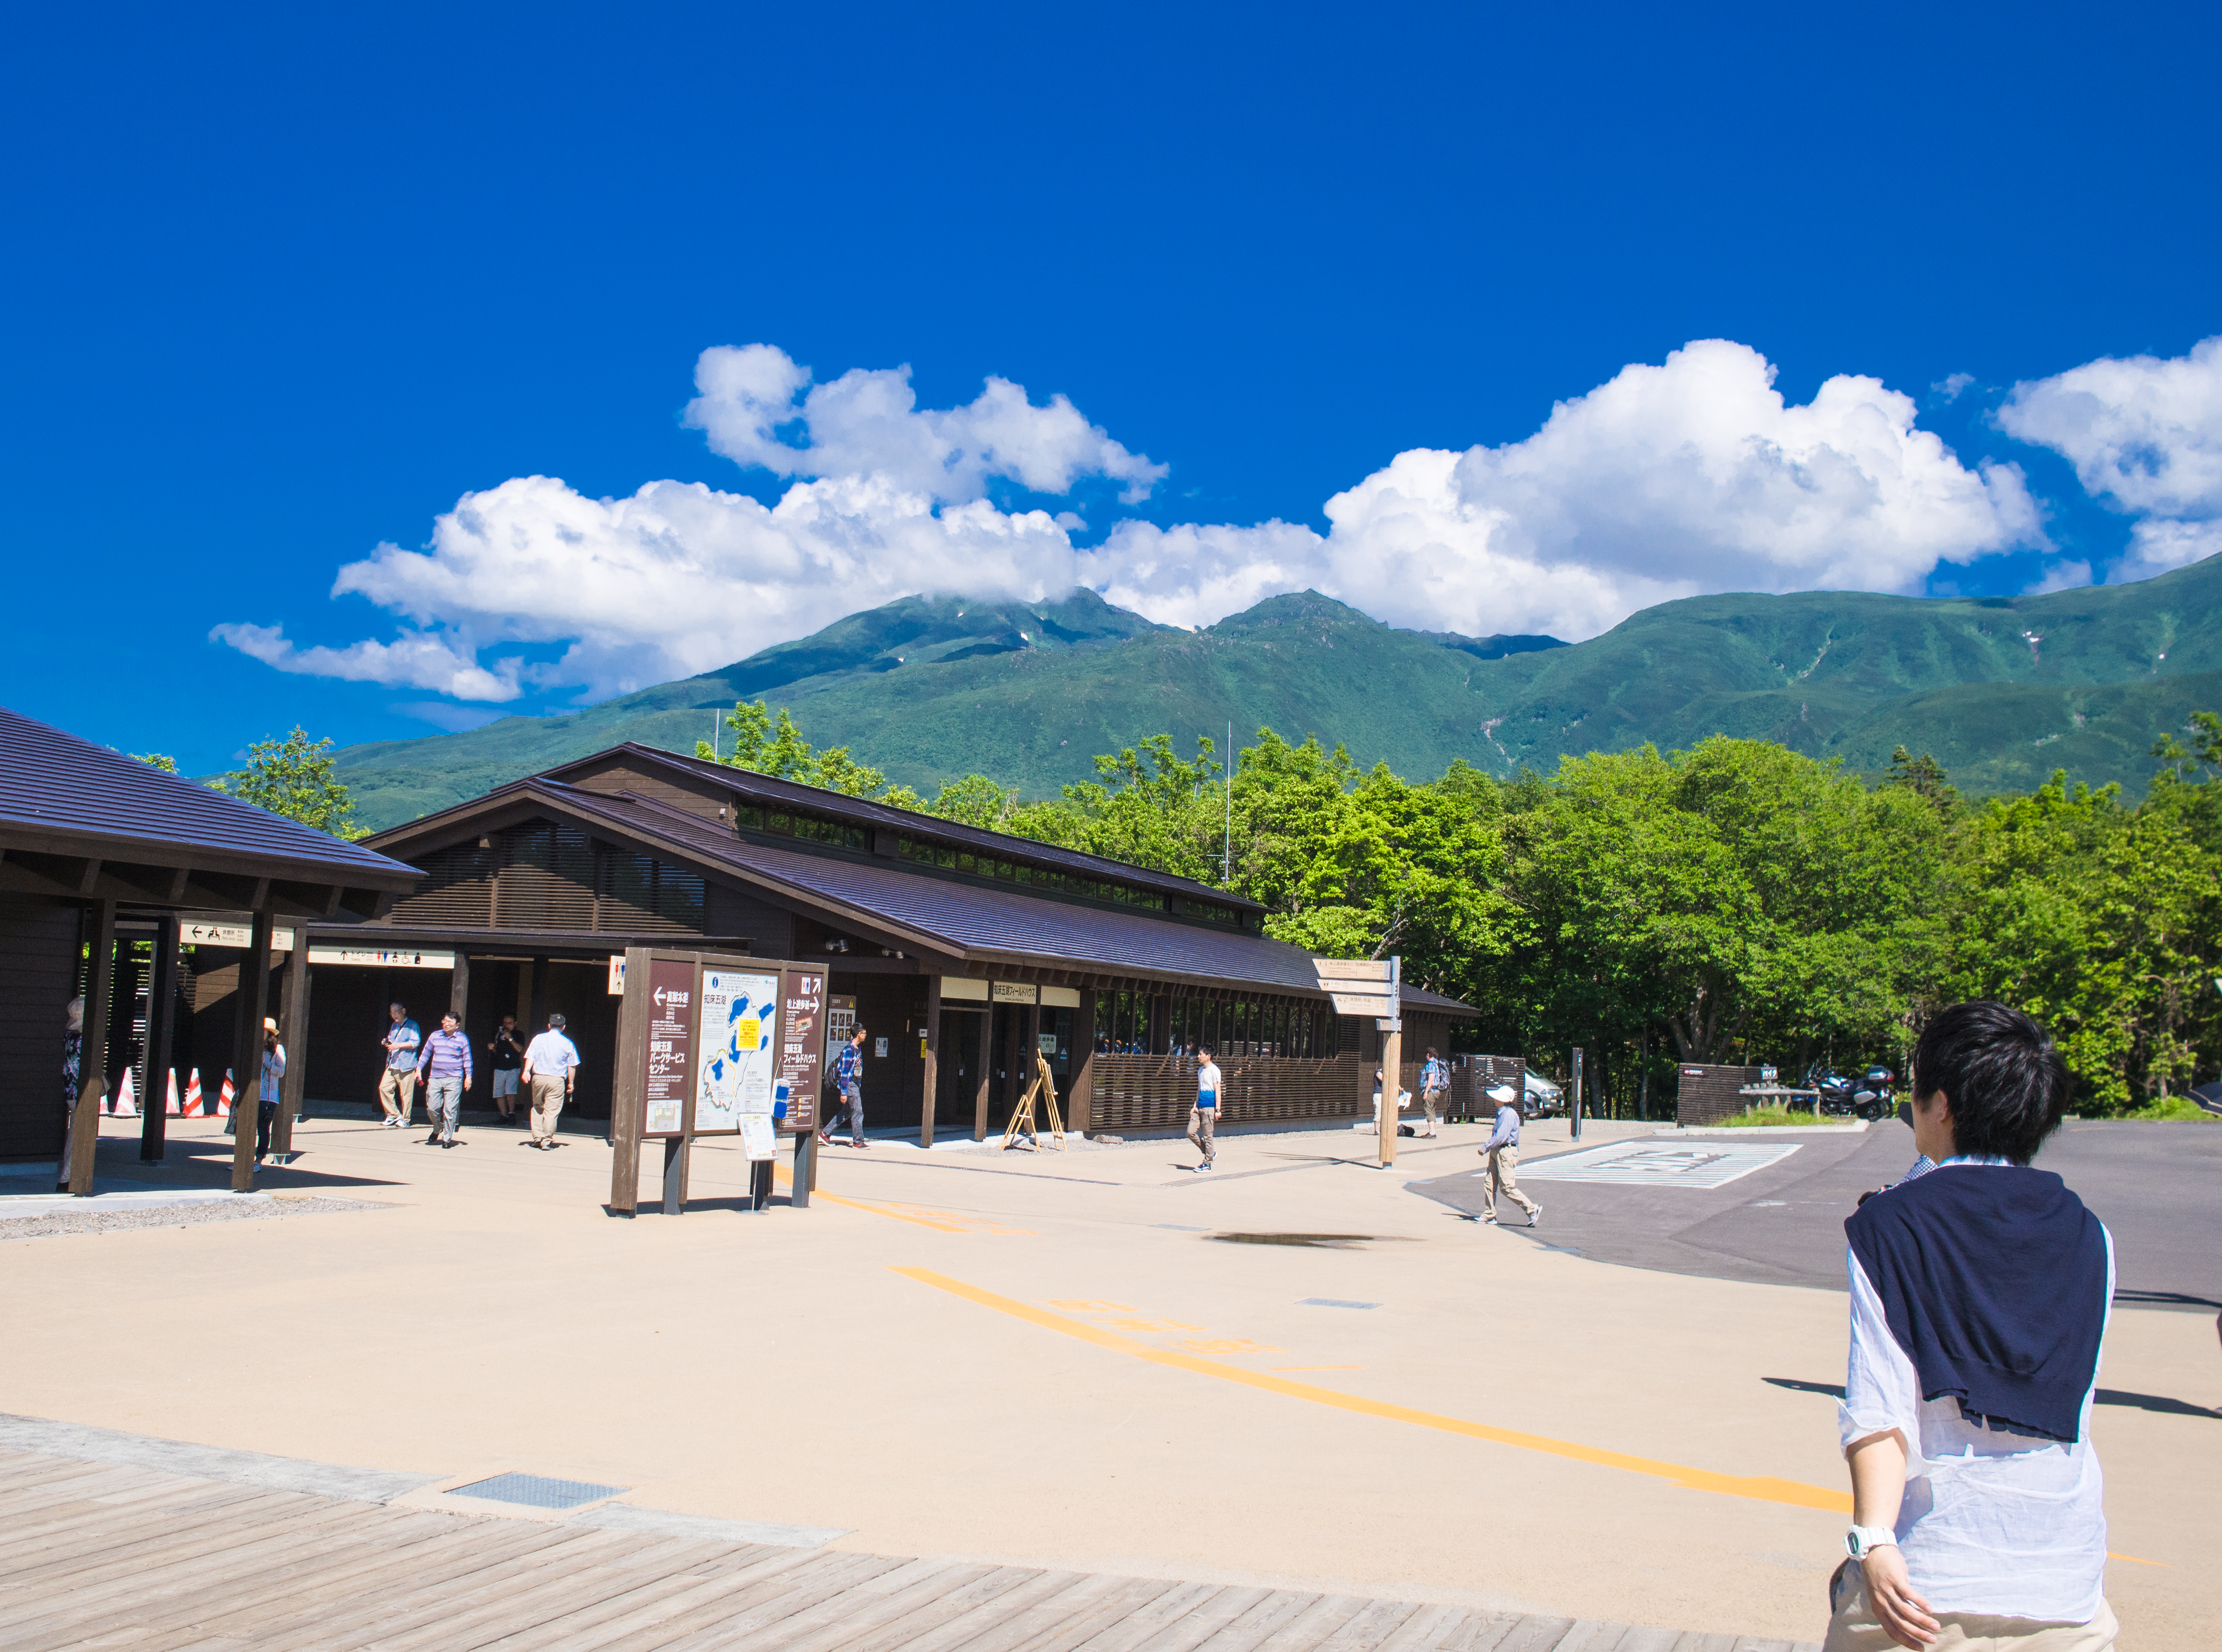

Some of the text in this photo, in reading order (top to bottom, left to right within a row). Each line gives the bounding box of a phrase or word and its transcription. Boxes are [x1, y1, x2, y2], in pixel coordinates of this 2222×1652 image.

[994, 984, 1035, 997] 知床五湖フィールドハウス
[704, 994, 726, 1005] 知床五湖
[650, 1052, 685, 1063] パークサービス
[784, 1053, 816, 1064] フィールドハウス
[649, 1063, 670, 1074] センター
[1763, 1069, 1777, 1078] バイク
